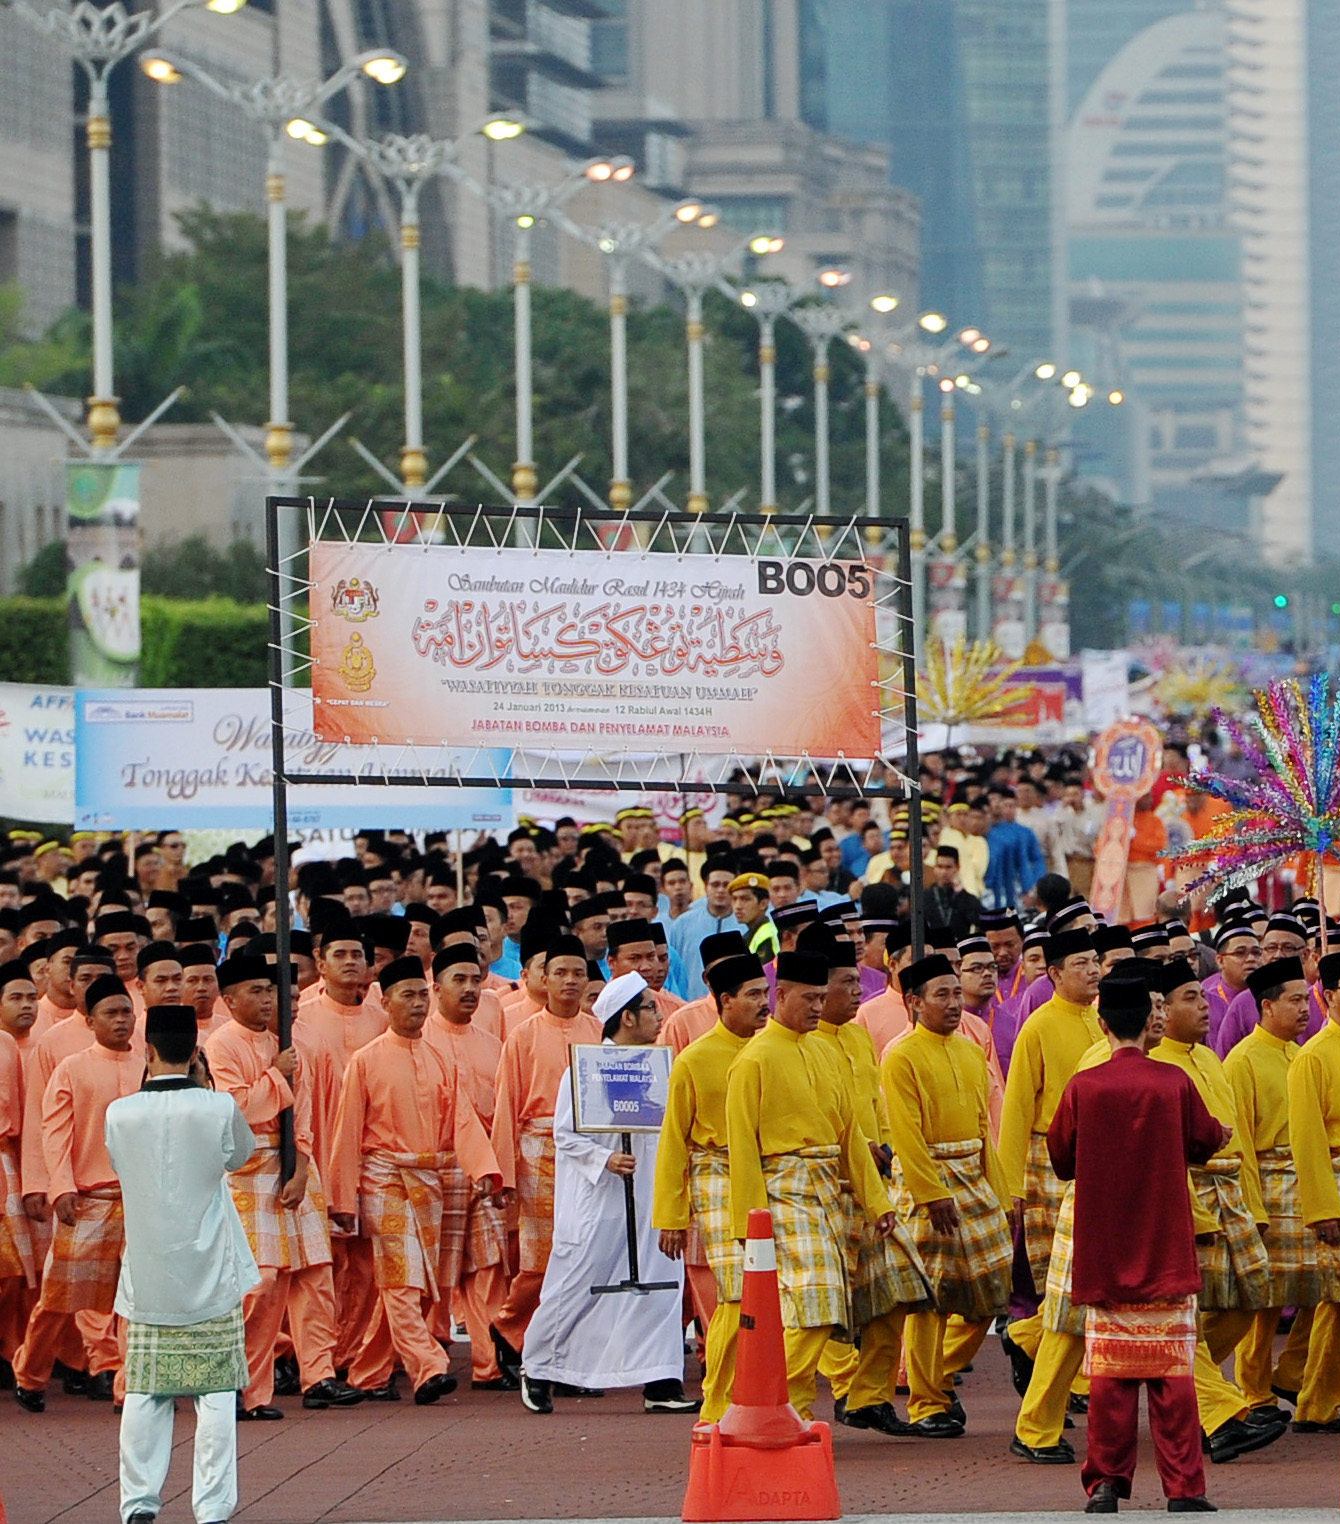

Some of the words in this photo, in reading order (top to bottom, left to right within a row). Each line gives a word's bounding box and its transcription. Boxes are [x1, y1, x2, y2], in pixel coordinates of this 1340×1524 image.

[447, 573, 524, 594] Sambutan
[529, 576, 599, 596] Maulidur
[602, 578, 648, 597] Rasul
[652, 581, 686, 598] 1434
[690, 580, 746, 605] Hijrah
[541, 681, 617, 698] TONGGAK
[619, 684, 692, 700] KESATUAN
[492, 702, 504, 712] 24
[506, 702, 541, 713] Januari
[543, 703, 566, 713] 2013
[614, 706, 626, 715] 12
[628, 705, 657, 716] Rabiul
[659, 706, 682, 716] Awal
[684, 707, 713, 717] 1434H
[472, 720, 523, 732] JABATAN
[526, 721, 567, 734] BOMBA
[570, 722, 596, 734] DAN
[599, 723, 670, 736] PENYELAMAT
[672, 725, 730, 737] MALAYSIA
[121, 756, 229, 799] Tonggak
